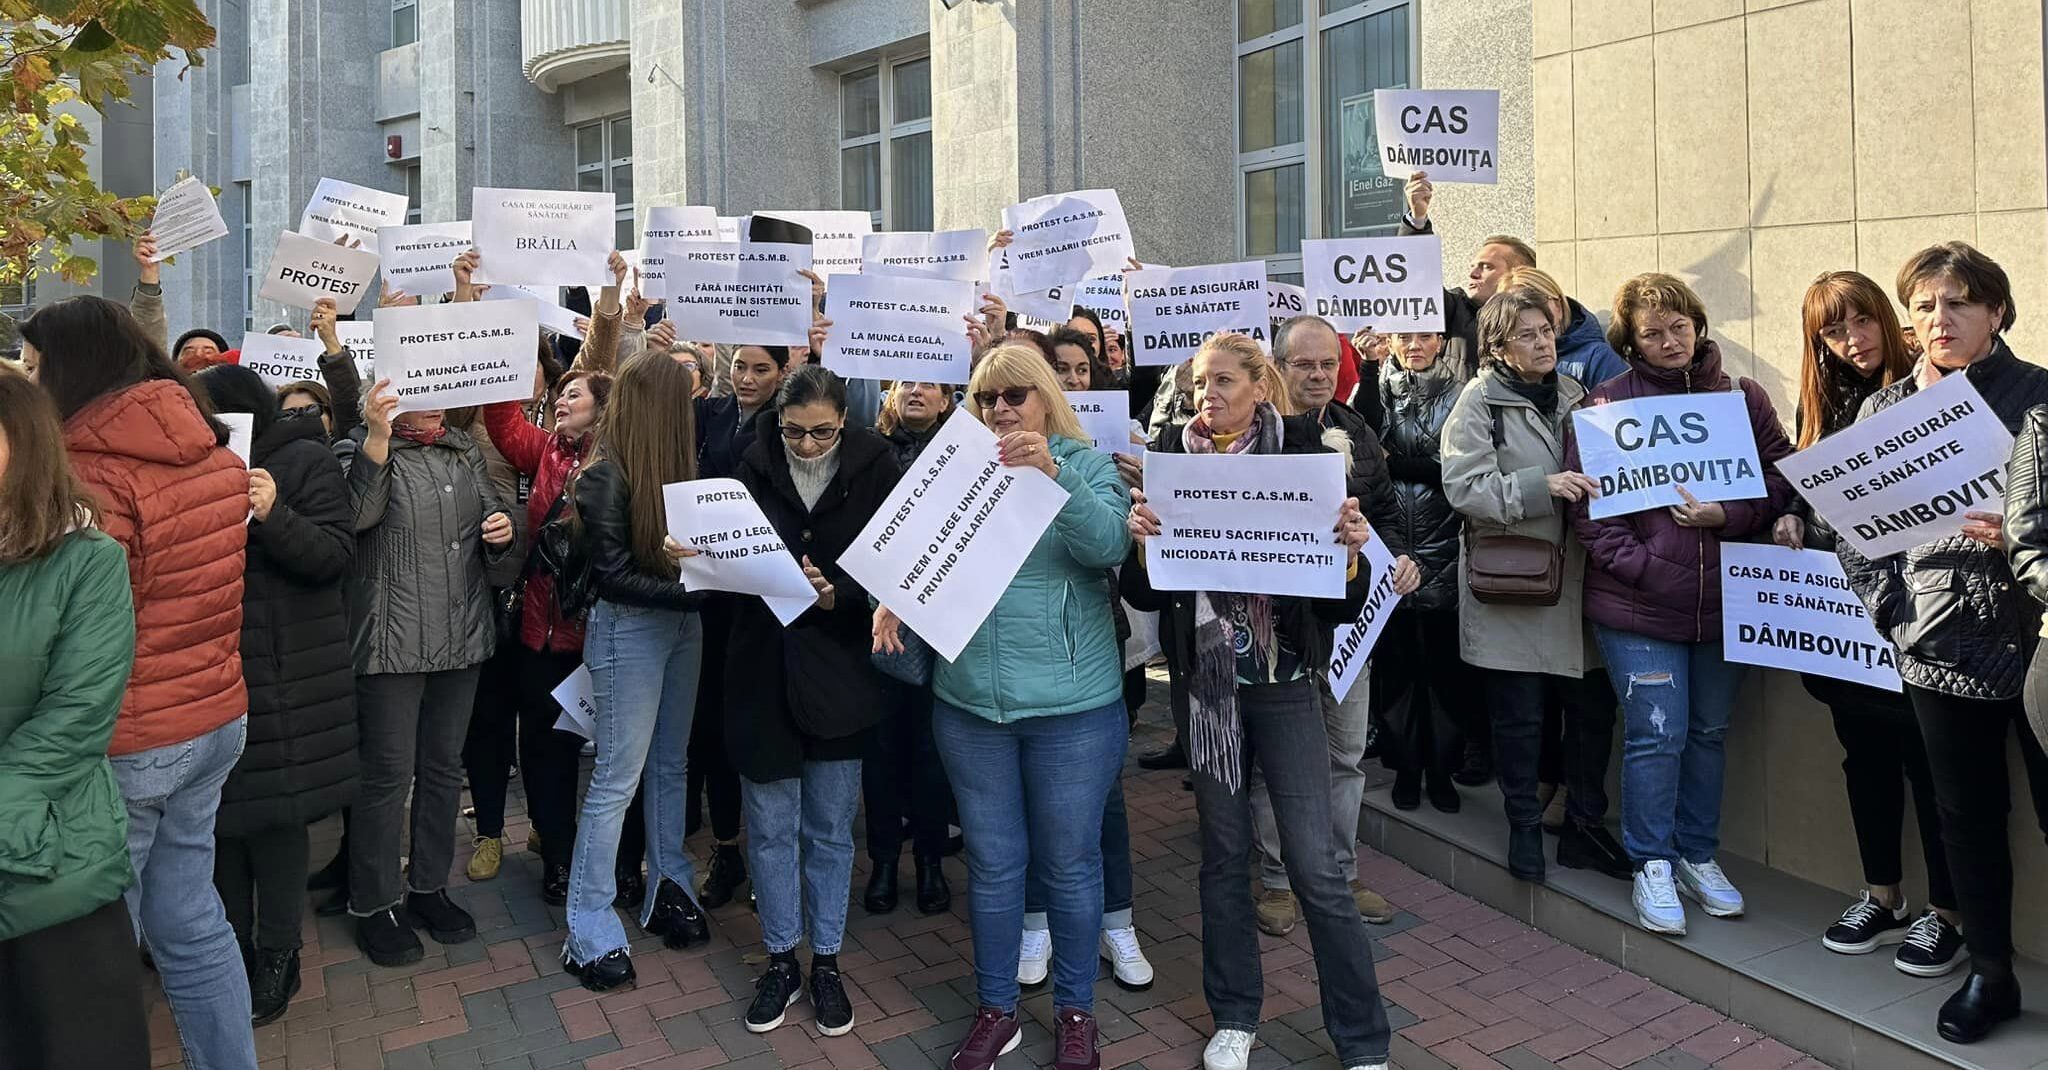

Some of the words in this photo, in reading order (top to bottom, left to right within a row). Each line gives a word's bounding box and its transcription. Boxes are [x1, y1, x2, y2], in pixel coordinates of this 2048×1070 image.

[1400, 105, 1468, 134] CAS
[1353, 179, 1373, 192] Enel
[1375, 176, 1394, 188] Gaz
[322, 195, 351, 208] PROTEST
[502, 201, 525, 209] CASA
[310, 214, 329, 224] VREM
[330, 217, 359, 230] SALARII
[360, 225, 377, 234] DECE
[1021, 217, 1061, 233] PROTEST
[1063, 209, 1107, 224] C.A.S.M.B.
[395, 243, 431, 251] PROTEST
[433, 240, 472, 249] C.A.S.M.B
[516, 235, 577, 250] BRĂILA
[1018, 249, 1044, 261] VREM
[1045, 241, 1080, 256] SALARII
[1081, 232, 1122, 247] DECENTE
[688, 253, 735, 261] PROTEST
[738, 254, 790, 262] C.A.S.M.B.
[883, 257, 925, 265] PROTEST
[927, 254, 968, 264] C.A.S.M.B.
[311, 260, 345, 275] C.N.A.S
[390, 267, 413, 275] VREM
[414, 264, 447, 273] SALARII
[1333, 253, 1408, 284] CAS
[279, 267, 360, 295] PROTEST
[1085, 286, 1096, 294] DE
[1097, 286, 1121, 296] SĂNĂ
[1134, 287, 1167, 299] CASA
[1170, 286, 1187, 296] DE
[1190, 279, 1259, 295] ASIGURĂRI
[677, 296, 733, 304] SALARIALE
[736, 296, 749, 305] ÎN
[750, 297, 801, 305] SISTEMUL
[849, 300, 897, 311] PROTEST
[899, 304, 950, 315] C.A.S.M.B.
[1155, 306, 1172, 316] DE
[1175, 300, 1241, 315] SĂNĂTATE
[719, 309, 759, 318] PUBLIC!
[400, 332, 455, 345] PROTEST
[458, 328, 514, 340] C.A.S.M.B.
[851, 332, 864, 340] LA
[348, 350, 375, 360] OTE
[841, 347, 871, 356] VREM
[873, 350, 913, 359] SALARII
[916, 352, 953, 362] EGALE!
[248, 362, 322, 381] PROTEST
[407, 370, 422, 379] LA
[397, 385, 430, 396] VREM
[433, 379, 477, 392] SALARII
[480, 374, 518, 386] EGALE!
[1071, 404, 1104, 413] S.M.B.
[1614, 412, 1709, 451] CAS
[1800, 464, 1847, 490] CASA
[1848, 452, 1873, 471] DE
[1874, 400, 1976, 459] ASIGURĂRI
[1842, 483, 1869, 502] DE
[1864, 439, 1965, 492] SĂNĂTATE
[696, 490, 748, 504] PROTEST
[872, 499, 916, 552] PROTEST
[913, 443, 960, 498] C.A.S.M.B.
[1174, 489, 1237, 499] PROTEST
[1242, 490, 1313, 502] C.A.S.M.B.
[1852, 461, 2010, 542] DÂMBOVIŢ
[900, 555, 933, 592] VREM
[928, 543, 939, 555] O
[938, 516, 962, 543] LEGE
[958, 460, 1000, 513] UNITARĂ
[1173, 528, 1221, 539] MEREU
[689, 531, 728, 546] VREM
[732, 529, 742, 539] O
[745, 526, 773, 537] LEGE
[917, 553, 958, 605] PRIVIND
[955, 473, 1015, 553] SALARIZAREA
[752, 543, 786, 556] SALA
[1161, 549, 1237, 561] NICIODATĂ
[1729, 565, 1774, 581] CASA
[1779, 569, 1801, 583] DE
[1805, 573, 1851, 591] ASIGU
[1757, 590, 1780, 605] DE
[1783, 593, 1865, 619] SĂNĂTATE
